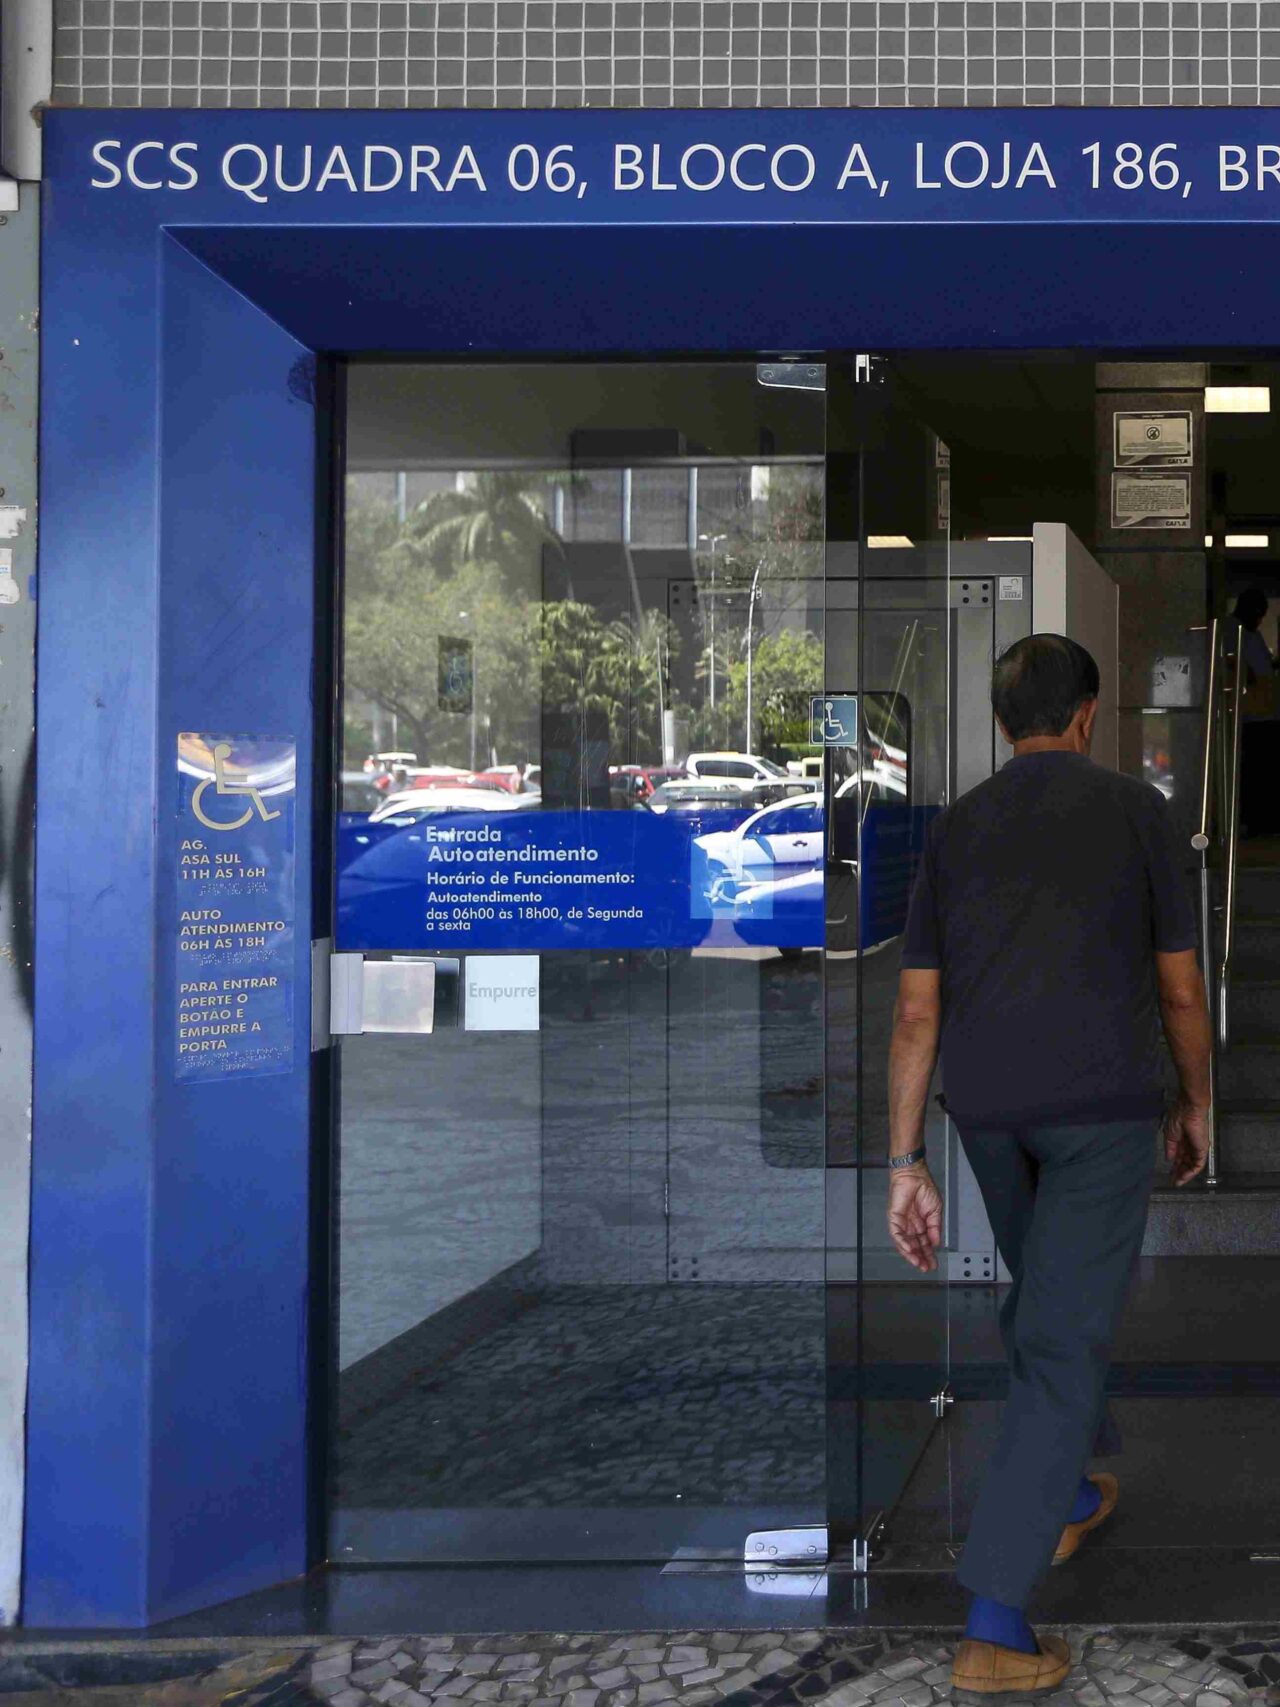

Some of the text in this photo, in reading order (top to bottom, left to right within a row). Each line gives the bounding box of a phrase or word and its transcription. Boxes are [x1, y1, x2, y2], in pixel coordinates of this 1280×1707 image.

[90, 140, 200, 191] SCS
[221, 143, 487, 203] QUADRA
[506, 143, 589, 200] 06,
[613, 143, 816, 193] BLOCO
[836, 143, 889, 198] A,
[914, 141, 1057, 191] LOJA
[1081, 141, 1193, 198] 186,
[426, 825, 501, 842] Entrada
[181, 840, 207, 850] AG.
[181, 853, 241, 865] ASA SUL
[428, 845, 599, 862] Autoatendimento
[182, 865, 265, 880] 11H ÀS 16H
[427, 871, 635, 885] Horário de Funcionamento:
[427, 891, 542, 903] Autoatendimento
[181, 909, 222, 920] AUTO
[426, 906, 643, 921] das 06h00 às 18h00, de Segunda
[180, 921, 286, 936] ATENDIMENTO
[426, 920, 471, 931] a sexta
[180, 936, 265, 951] 06H ÀS 18H
[180, 977, 278, 993] PARA ENTRAR
[469, 982, 537, 1002] Empurre
[180, 993, 248, 1009] APERTE O
[236, 1008, 244, 1018] E
[180, 1021, 261, 1038] EMPURRE A
[179, 1039, 227, 1053] PORTA
